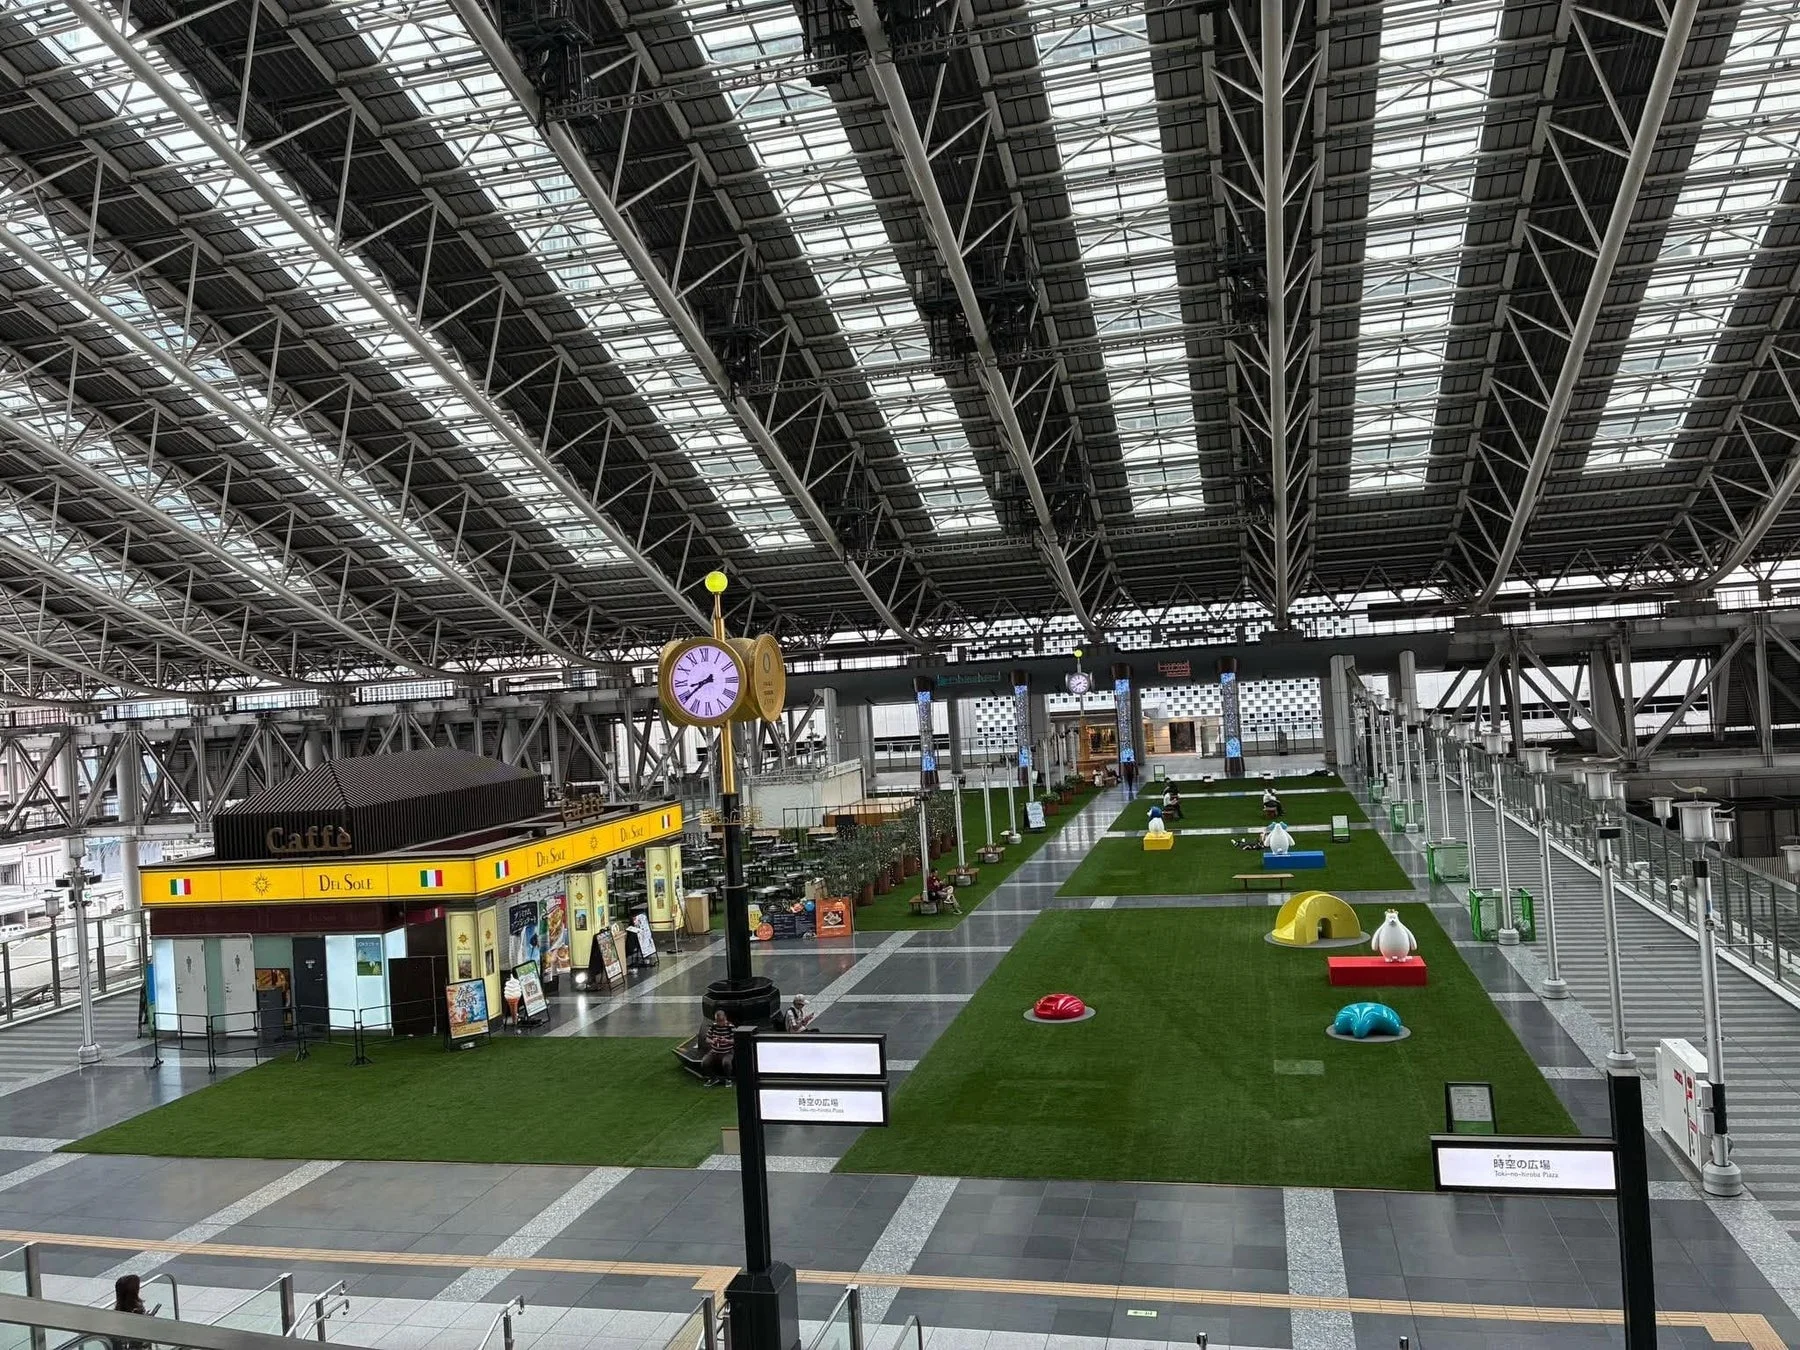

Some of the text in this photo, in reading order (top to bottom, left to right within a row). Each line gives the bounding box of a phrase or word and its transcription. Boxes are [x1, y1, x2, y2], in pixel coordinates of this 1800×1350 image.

[266, 824, 353, 854] Caffè
[1493, 1158, 1551, 1170] 時空の広場
